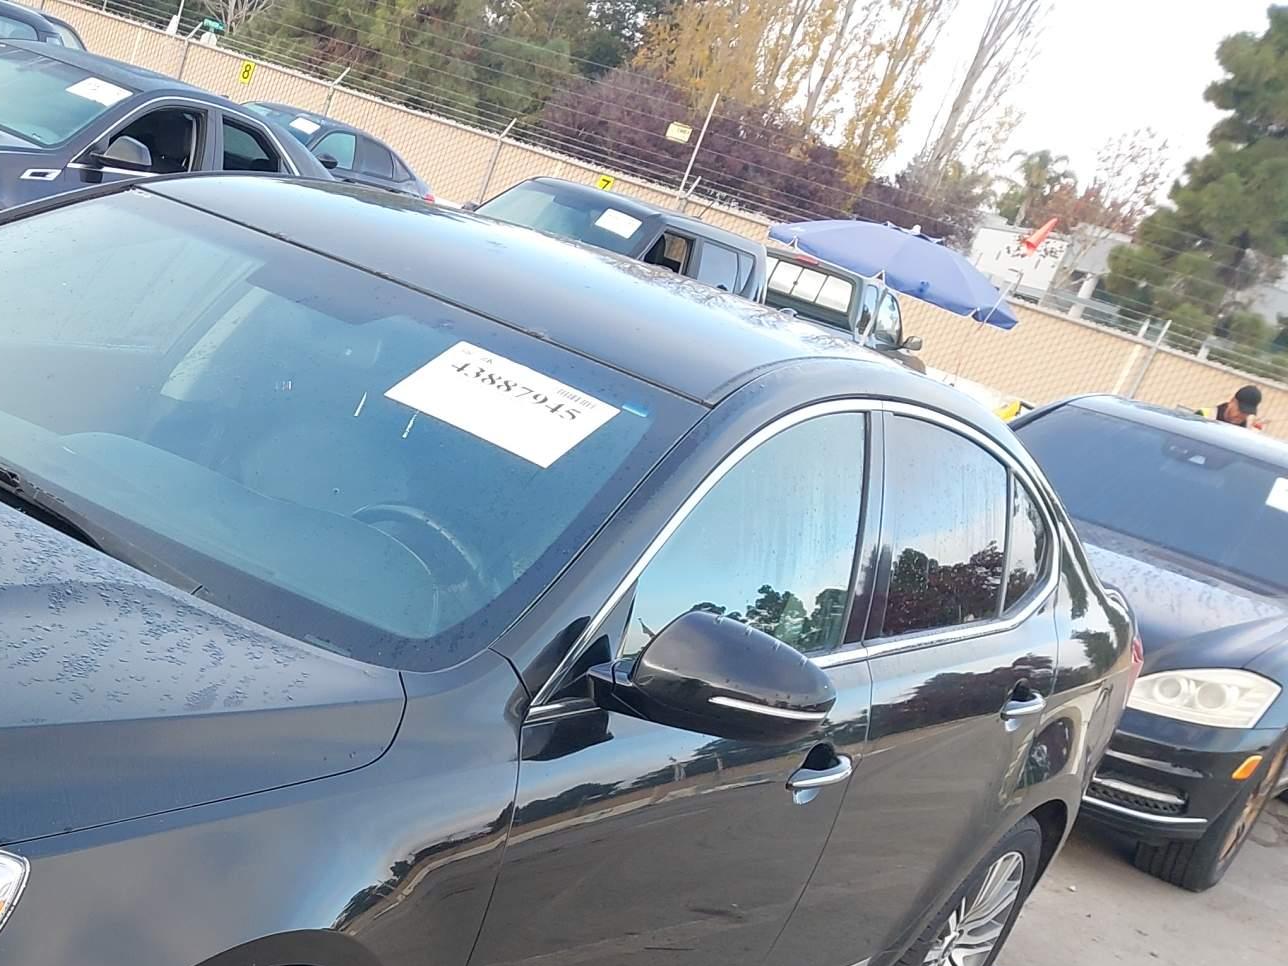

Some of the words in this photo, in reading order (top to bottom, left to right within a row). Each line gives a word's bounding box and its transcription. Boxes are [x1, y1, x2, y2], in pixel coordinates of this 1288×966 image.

[242, 63, 252, 80] 8
[601, 178, 611, 190] 7
[451, 362, 582, 421] 43887945
